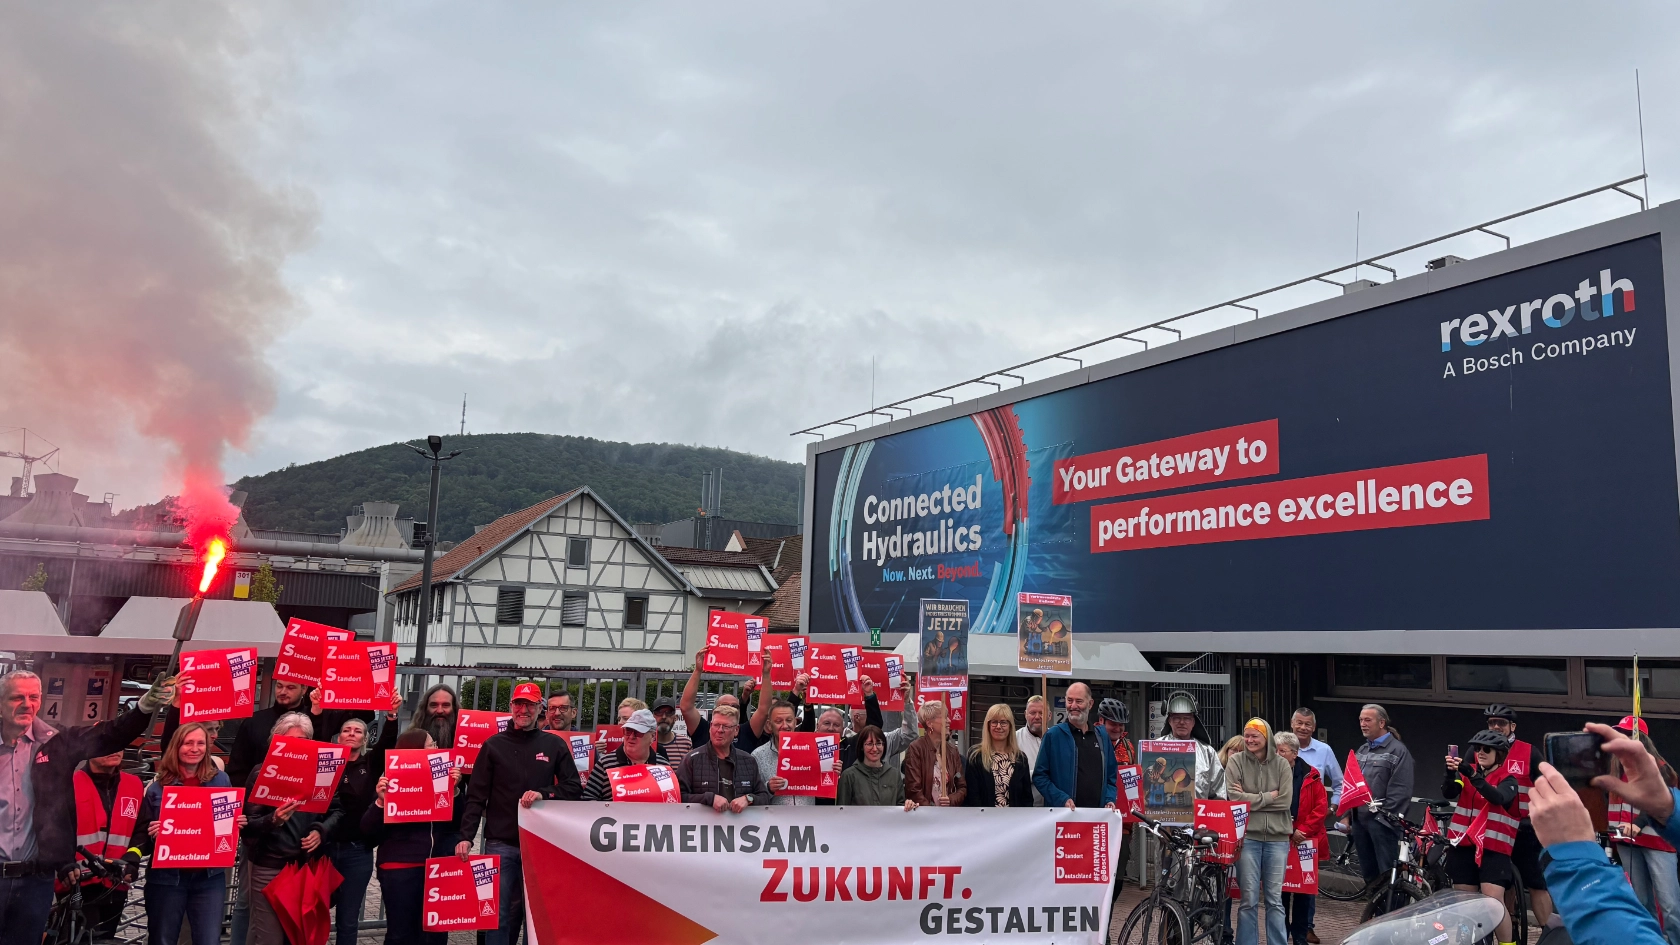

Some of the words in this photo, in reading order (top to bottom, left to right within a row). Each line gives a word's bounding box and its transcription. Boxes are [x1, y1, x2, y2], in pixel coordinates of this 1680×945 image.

[1440, 268, 1636, 353] rexroth
[1443, 361, 1456, 379] A
[1463, 347, 1523, 375] Bosch
[1531, 327, 1636, 361] Company
[1059, 464, 1111, 492] Your
[1115, 444, 1231, 484] Gateway
[1235, 437, 1267, 465] to
[863, 474, 983, 525] Connected
[1098, 501, 1271, 547] performance
[1278, 478, 1473, 523] excellence
[862, 518, 983, 567] Hydraulics
[882, 567, 906, 582] Now.
[908, 565, 935, 581] Next.
[937, 561, 983, 582] Beyond.
[927, 617, 963, 631] JETZT
[937, 604, 966, 612] BRAUCHEN
[47, 702, 58, 719] 4
[87, 702, 98, 719] 3
[1056, 712, 1065, 724] 2
[589, 816, 830, 854] GEMEINSAM.
[759, 859, 973, 903] ZUKUNFT.
[919, 902, 1099, 935] GESTALTEN
